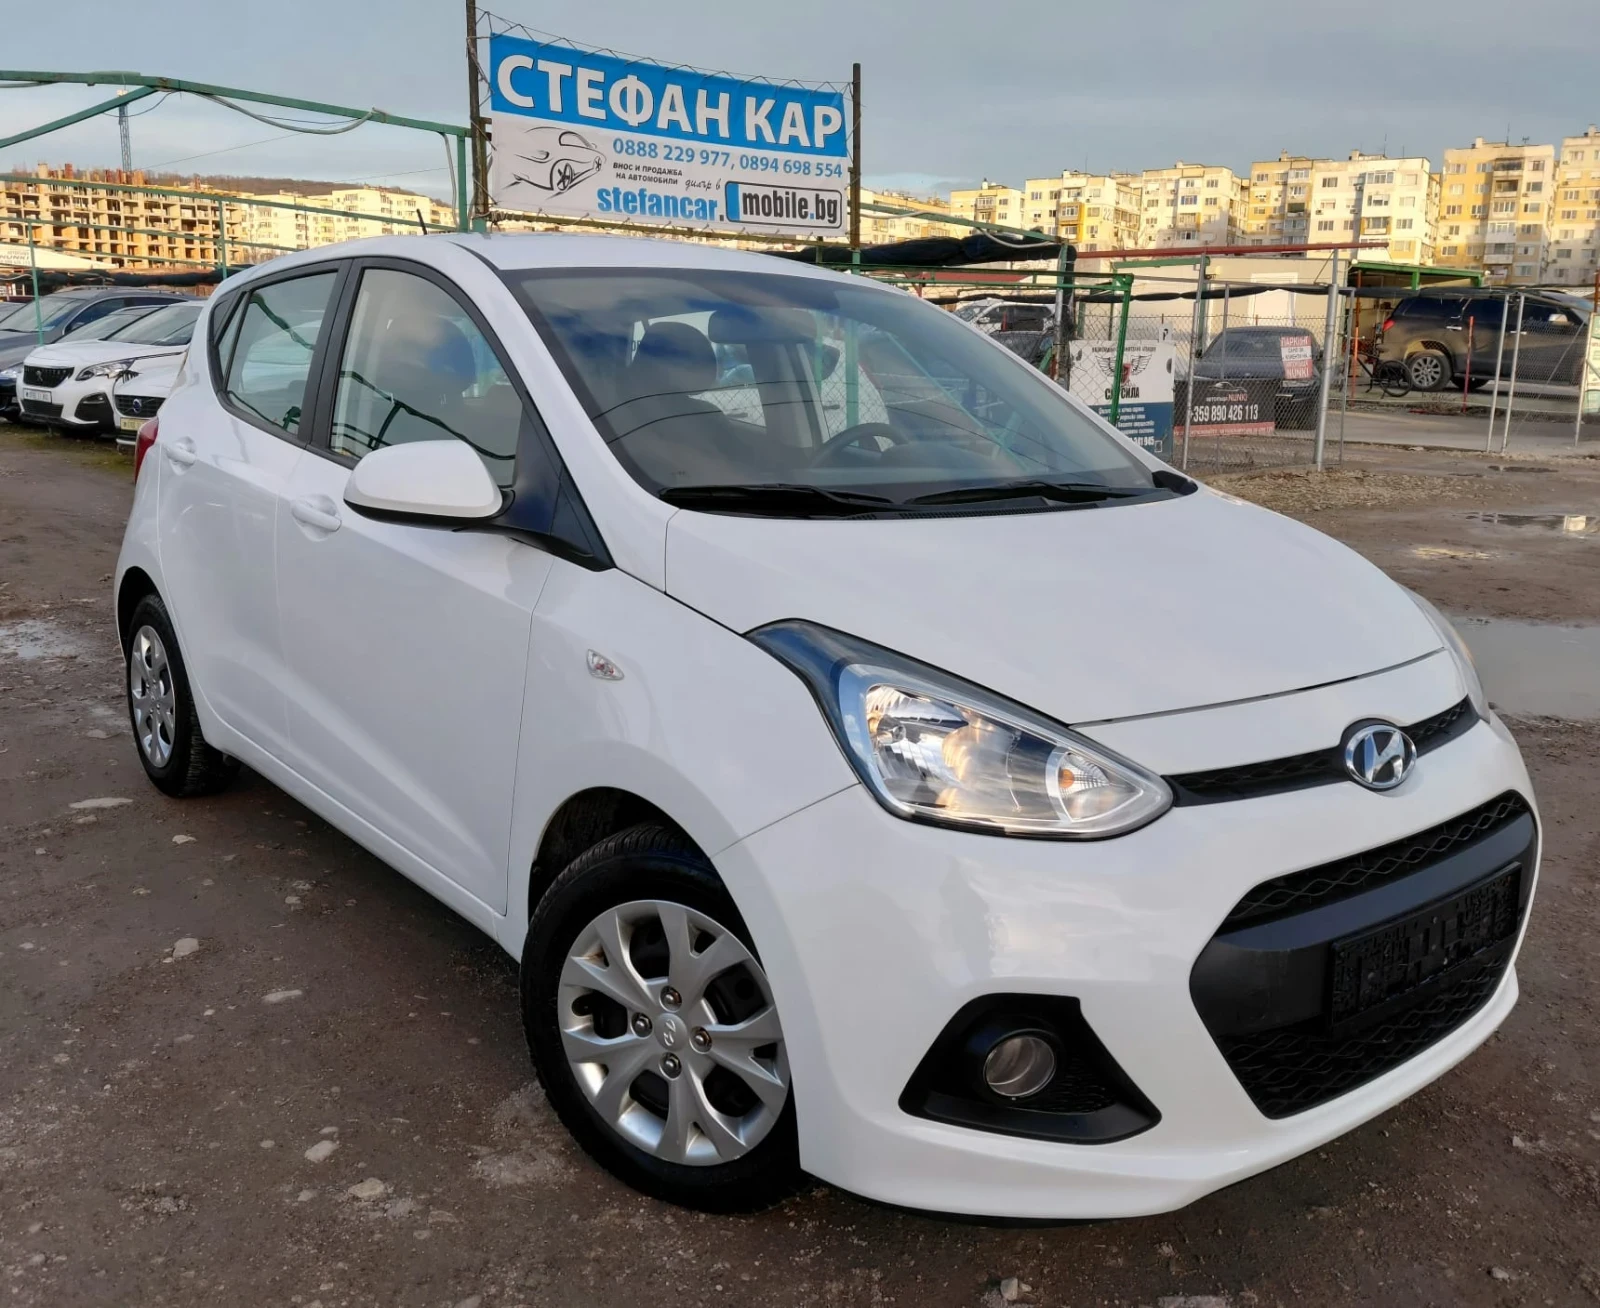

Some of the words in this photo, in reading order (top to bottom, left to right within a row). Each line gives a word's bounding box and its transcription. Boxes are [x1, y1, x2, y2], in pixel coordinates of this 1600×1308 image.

[497, 54, 731, 139] СТЕФАН
[745, 96, 843, 149] КАР
[612, 138, 659, 159] 0888
[663, 144, 696, 163] 229
[700, 149, 735, 171] 977,
[739, 154, 779, 173] 0894
[783, 159, 812, 176] 698
[815, 162, 843, 178] 554
[612, 162, 634, 171] ВНОС
[635, 164, 641, 172] И
[642, 165, 683, 177] ПРОДАЖБА
[615, 171, 626, 180] НА
[628, 173, 678, 185] АВТОМОБИЛИ
[742, 189, 838, 224] mobile.bg
[1211, 404, 1227, 422] 890
[1228, 403, 1243, 421] 426
[1245, 402, 1259, 421] 113
